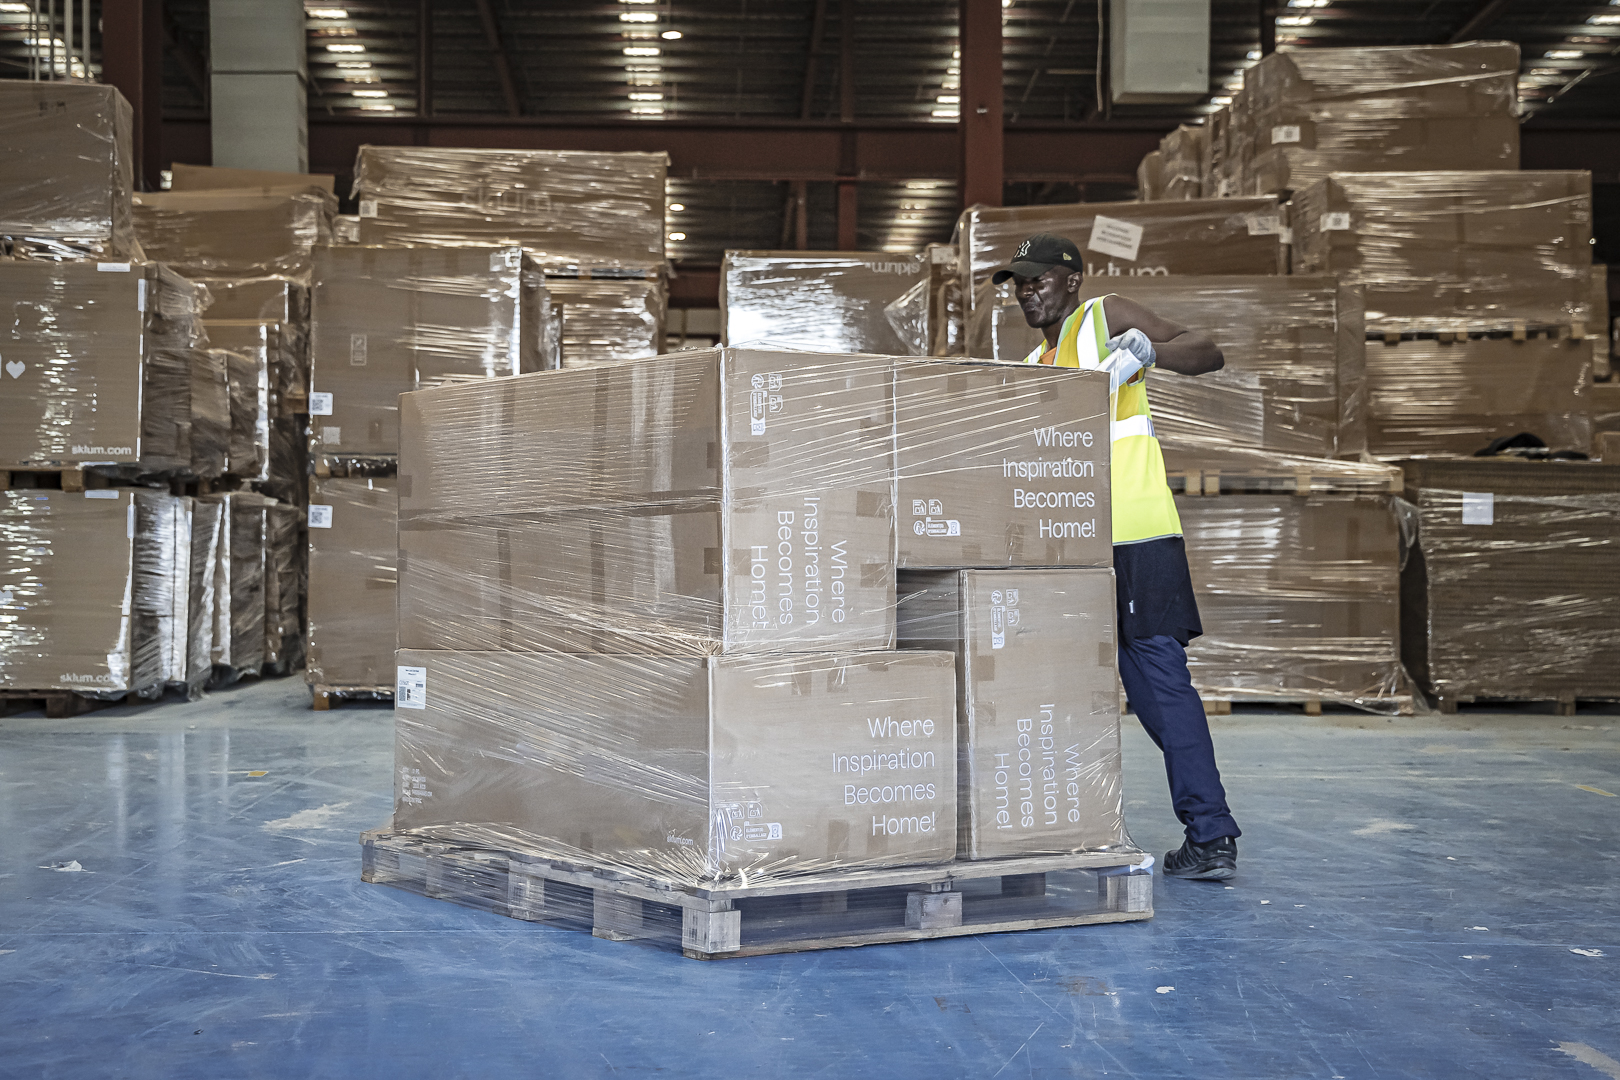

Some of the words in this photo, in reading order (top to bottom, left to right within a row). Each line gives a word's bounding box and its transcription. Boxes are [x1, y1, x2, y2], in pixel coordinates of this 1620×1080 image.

[71, 443, 132, 456] sklum.com
[1033, 427, 1094, 448] Where
[1003, 456, 1094, 482] Inspiration
[1013, 488, 1095, 509] Becomes
[1039, 518, 1096, 539] Home!
[777, 510, 795, 625] Becomes
[800, 496, 823, 624] Inspiration
[750, 545, 770, 629] Home!
[830, 539, 848, 623] Where
[866, 716, 935, 738] Where
[832, 748, 936, 776] Inspiration
[1016, 718, 1034, 828] Becomes
[1038, 703, 1060, 825] Inspiration
[844, 783, 936, 806] Becomes
[994, 753, 1013, 830] Home!
[1063, 742, 1082, 823] Where
[872, 811, 936, 837] Home!
